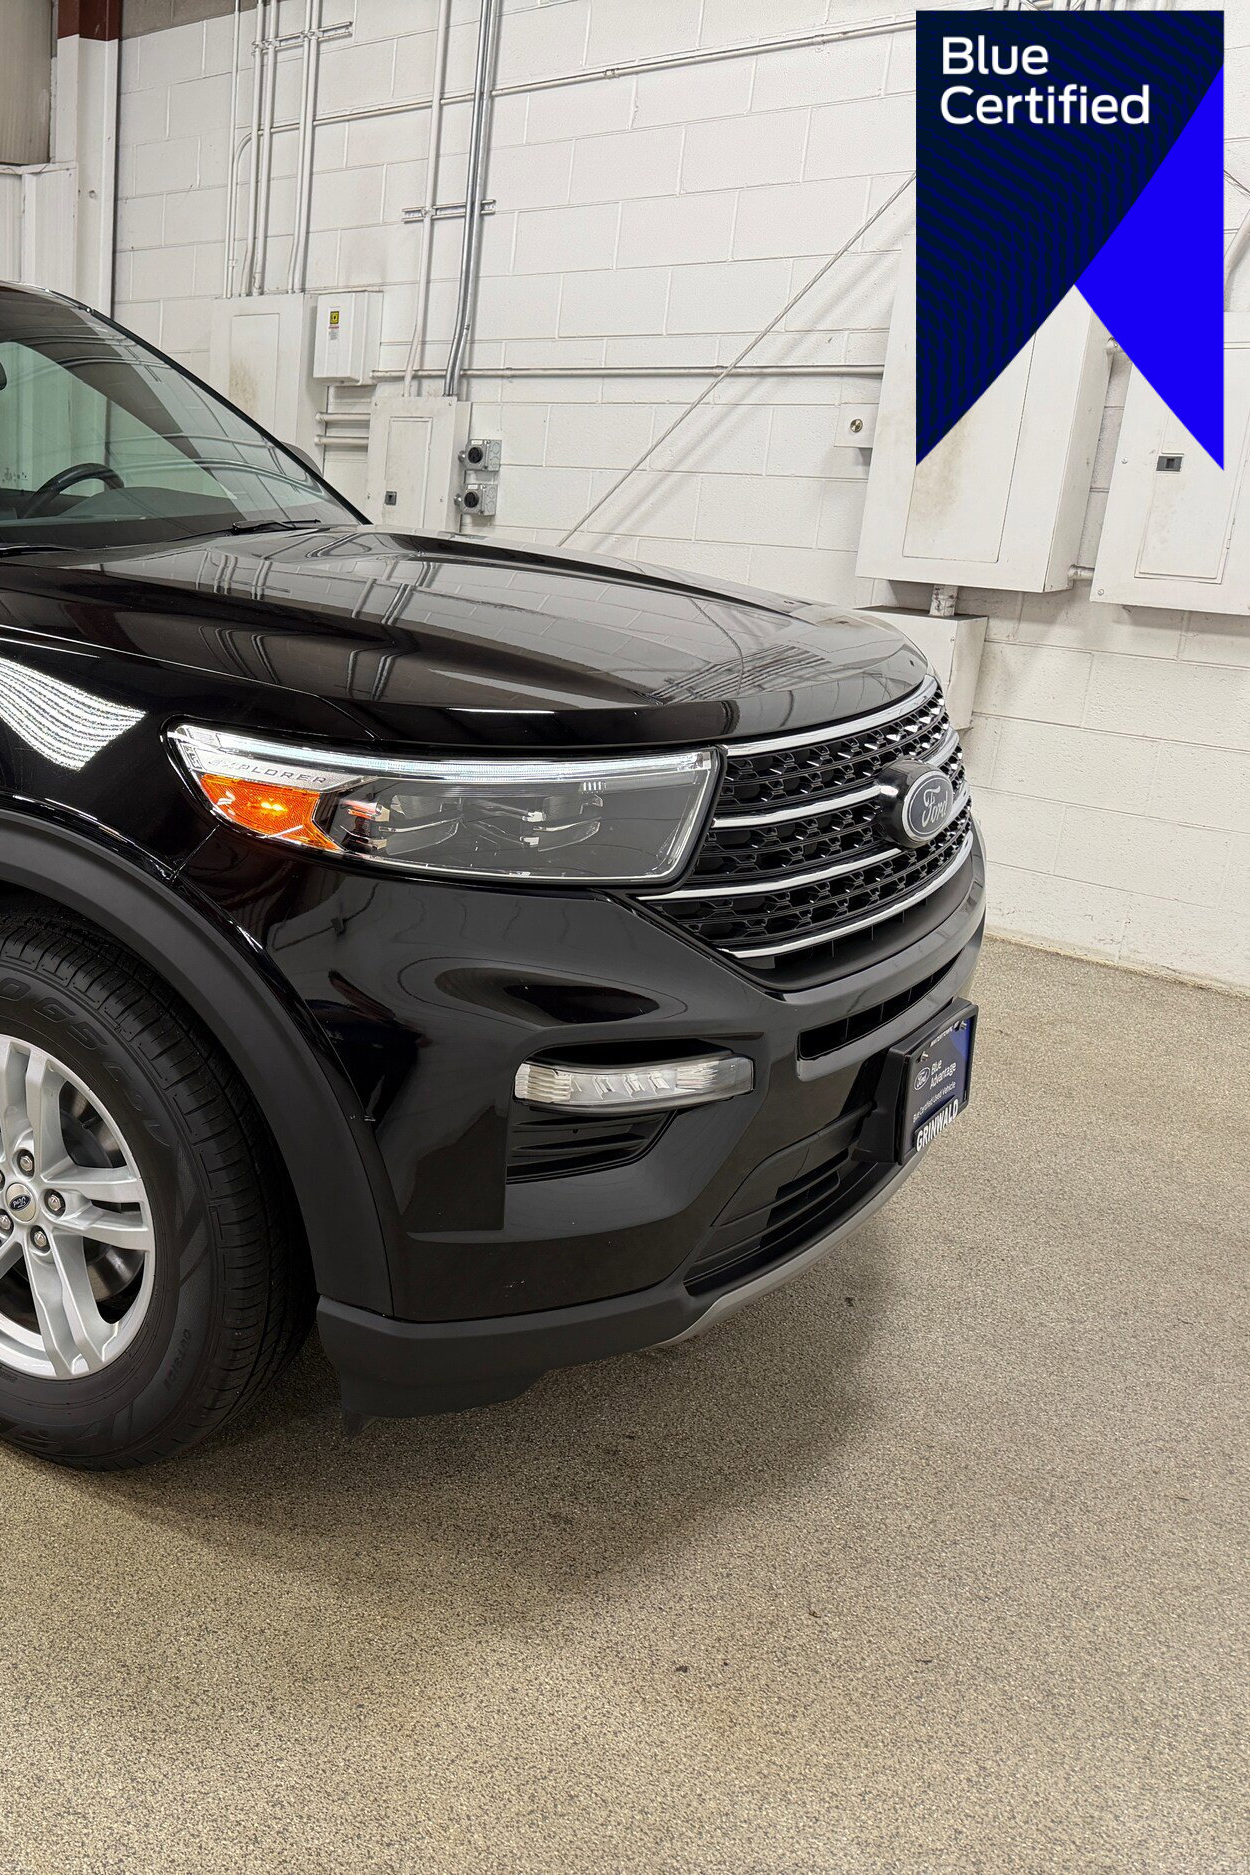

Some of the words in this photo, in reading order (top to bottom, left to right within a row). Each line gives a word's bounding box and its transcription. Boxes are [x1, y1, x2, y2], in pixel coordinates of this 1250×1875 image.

[921, 785, 949, 828] Ford
[930, 1062, 956, 1090] Advantage
[931, 1060, 942, 1075] Blue
[916, 1099, 959, 1152] GRINWALD
